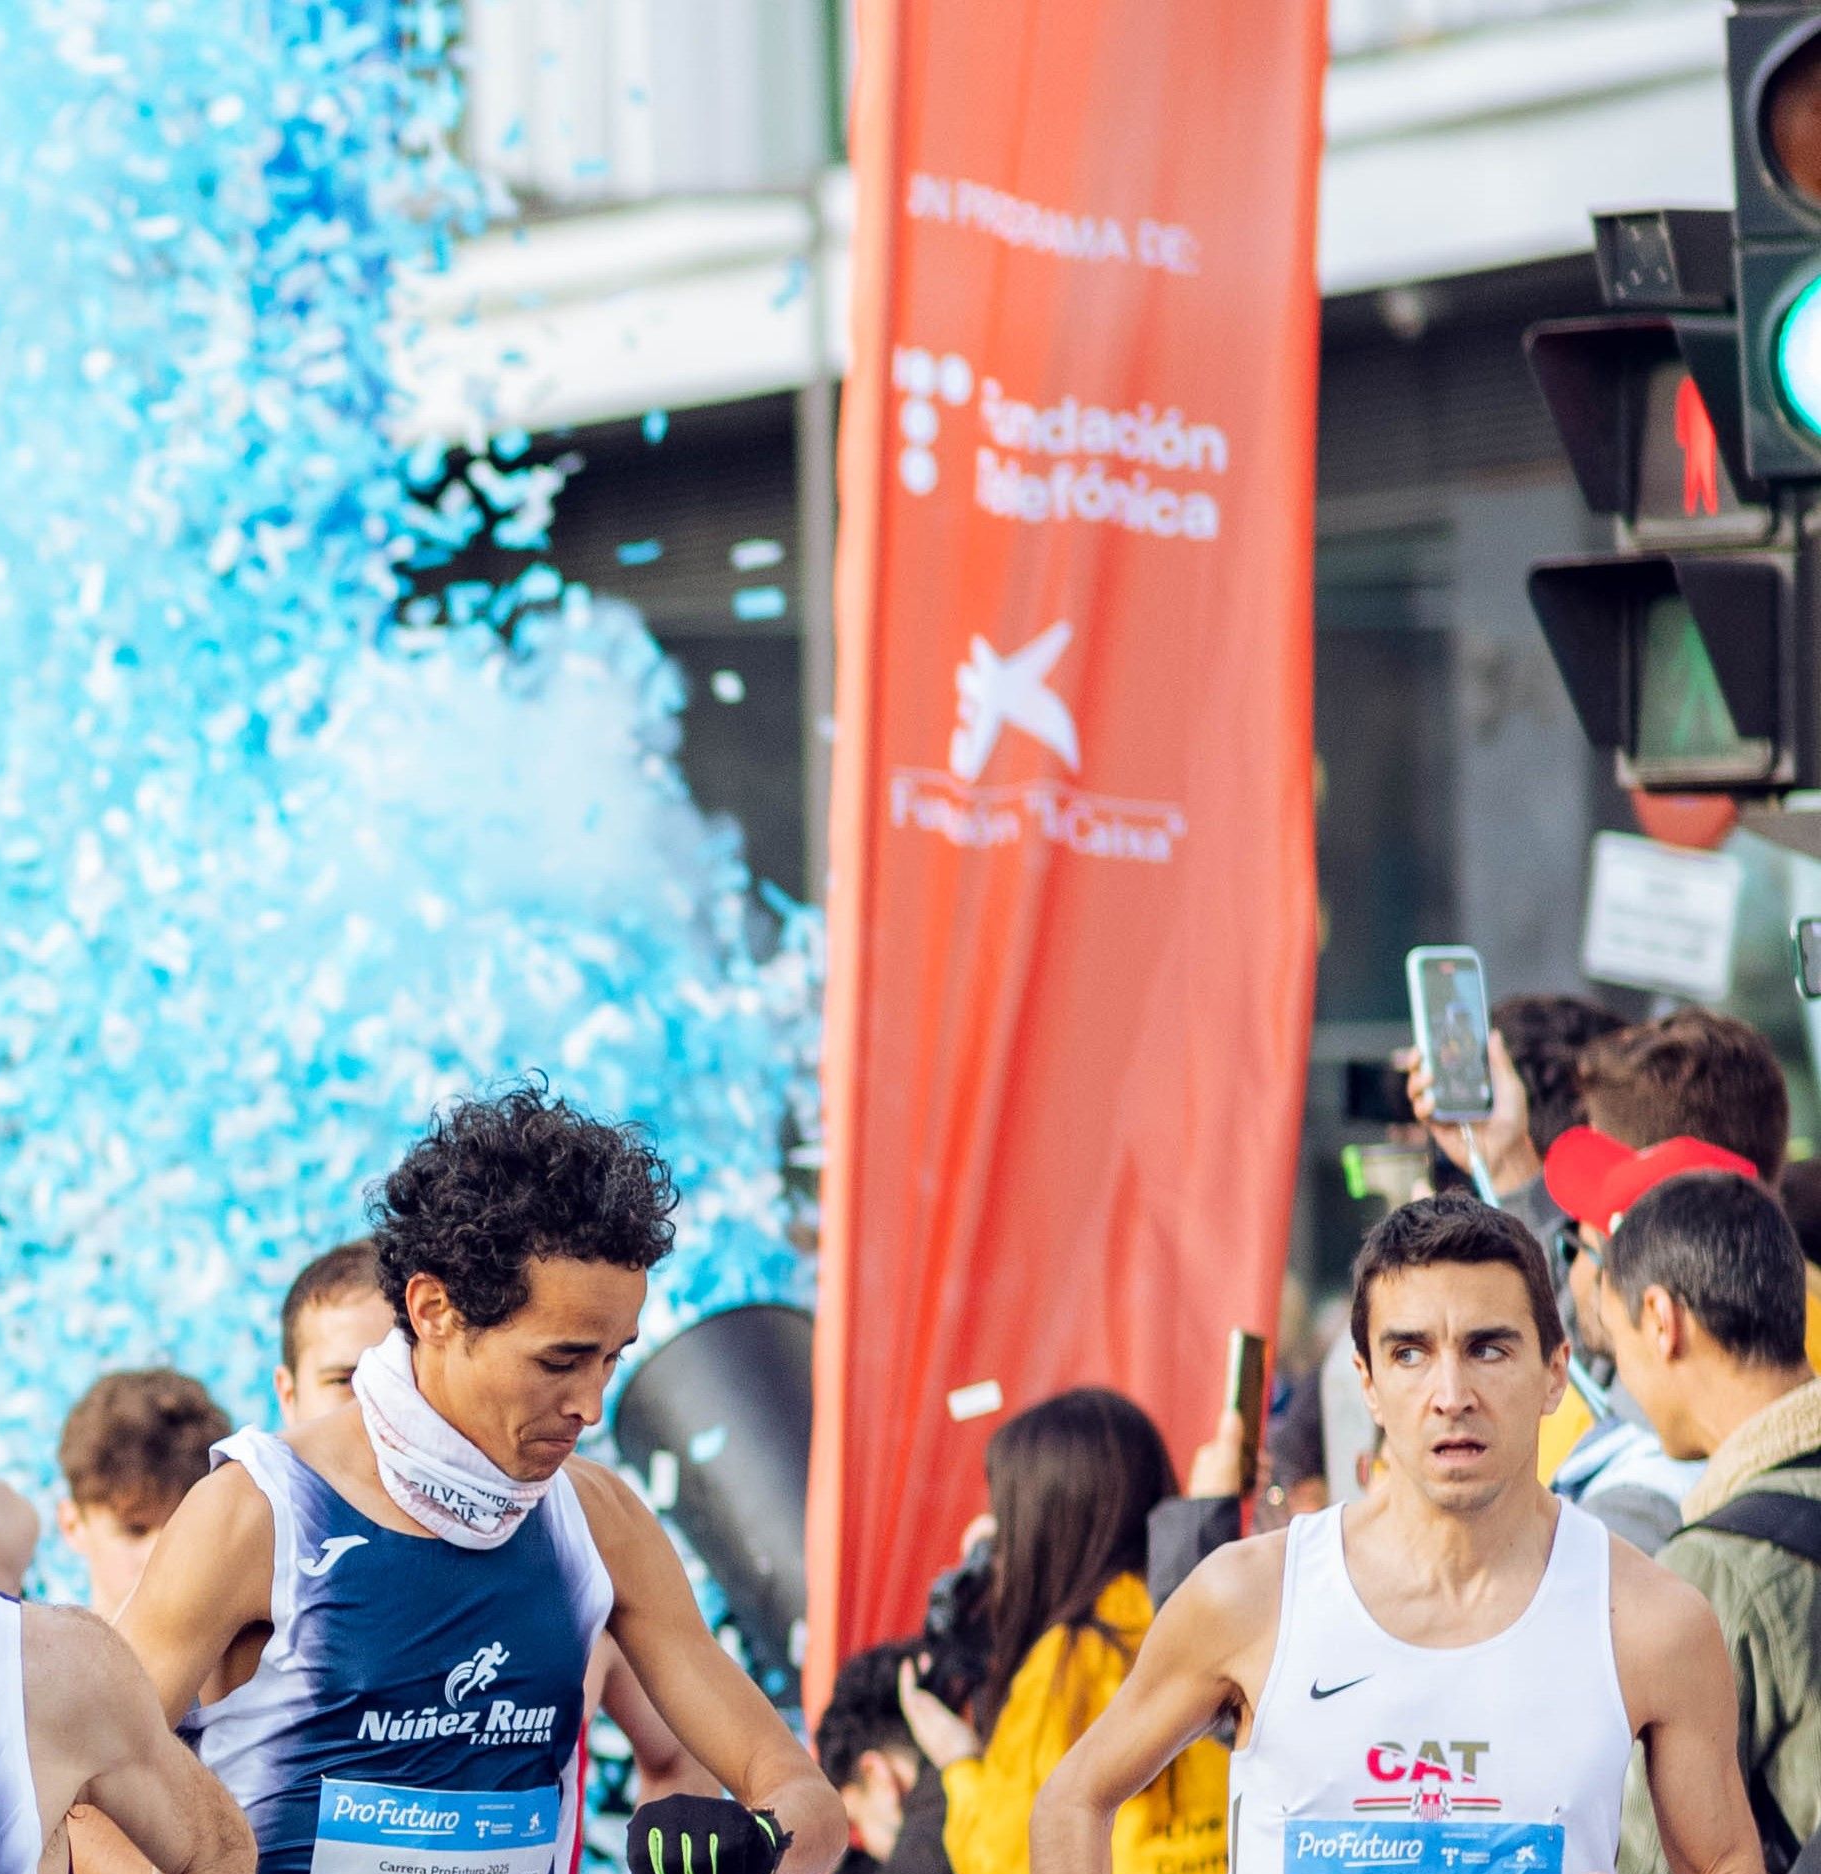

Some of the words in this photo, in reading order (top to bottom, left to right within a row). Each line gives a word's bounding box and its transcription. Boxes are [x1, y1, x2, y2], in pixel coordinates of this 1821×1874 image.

[357, 1706, 480, 1742] Núñez
[485, 1699, 557, 1733] Run
[469, 1730, 551, 1745] TALAVERA
[1366, 1740, 1490, 1783] CAT
[333, 1794, 461, 1831] ProFuturo
[1296, 1830, 1424, 1860] ProFuturo
